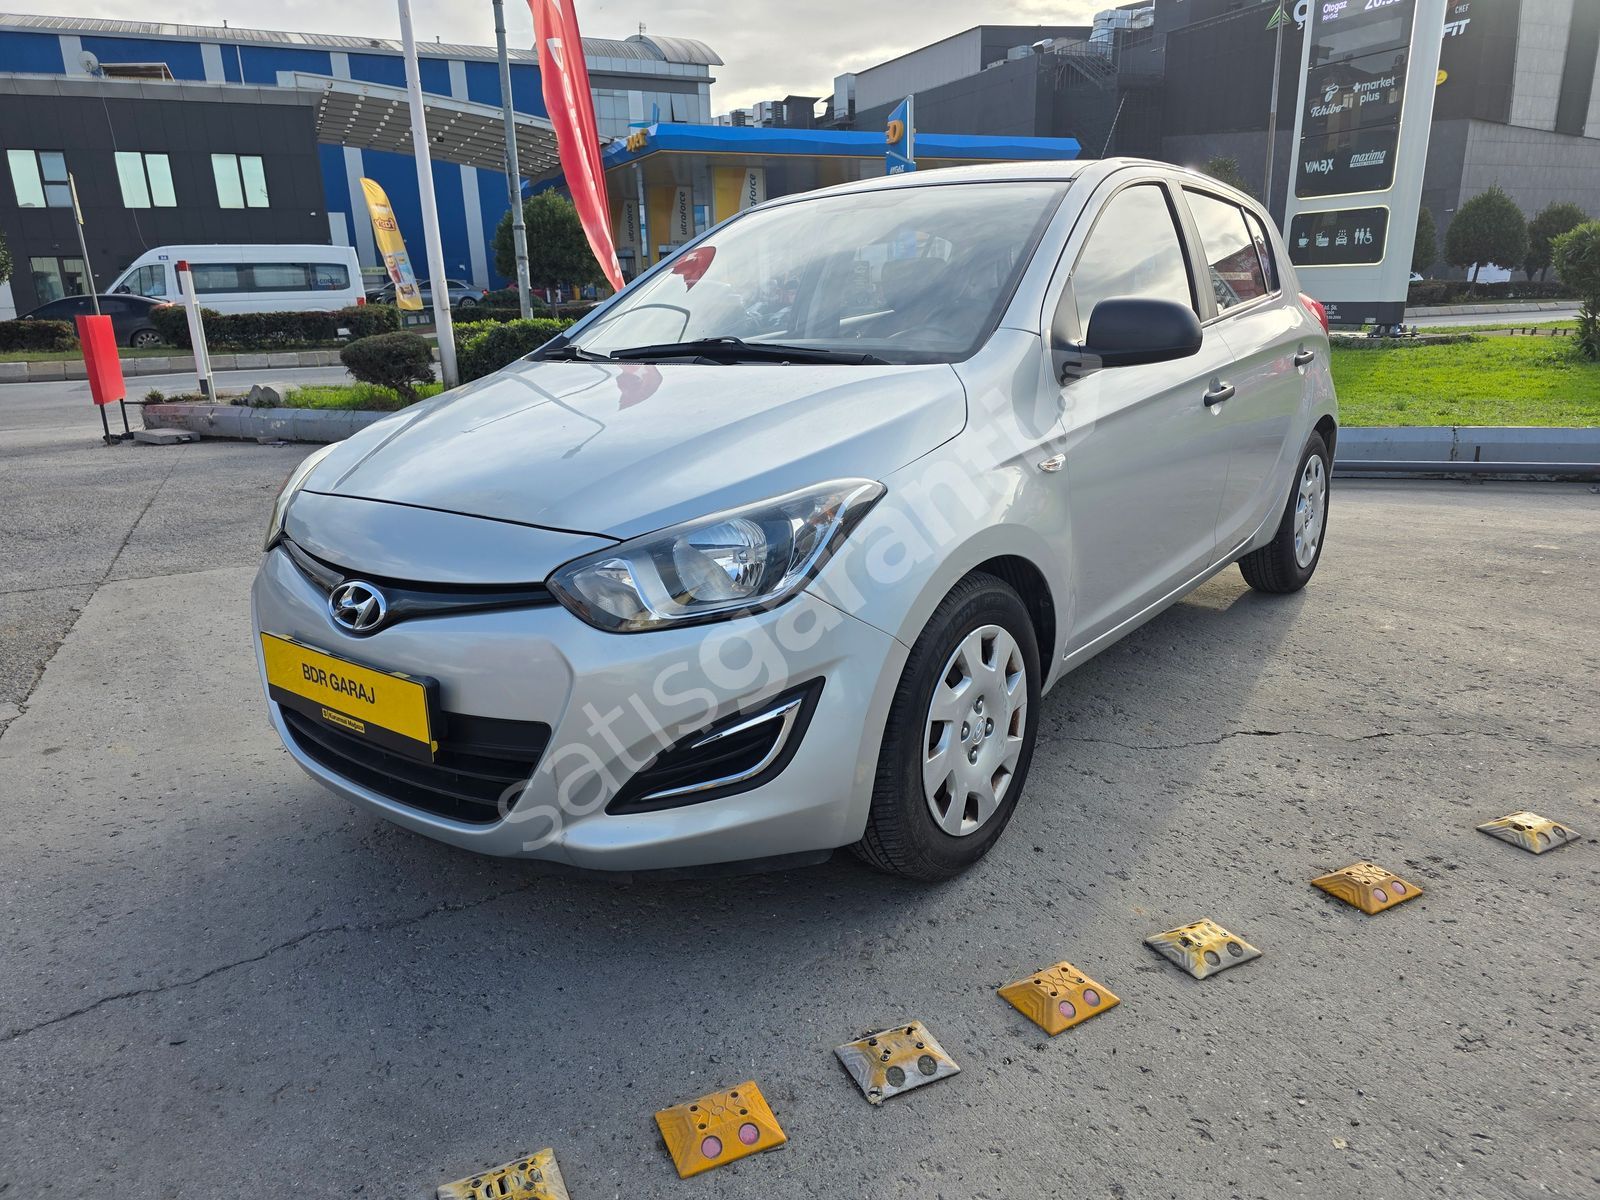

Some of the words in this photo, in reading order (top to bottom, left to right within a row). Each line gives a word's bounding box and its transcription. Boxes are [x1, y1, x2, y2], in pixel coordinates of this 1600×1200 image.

[1359, 92, 1380, 106] plus
[1310, 103, 1345, 118] Tchibo
[1350, 149, 1386, 163] maxima
[302, 662, 328, 688] BDR
[329, 673, 376, 705] GARAJ
